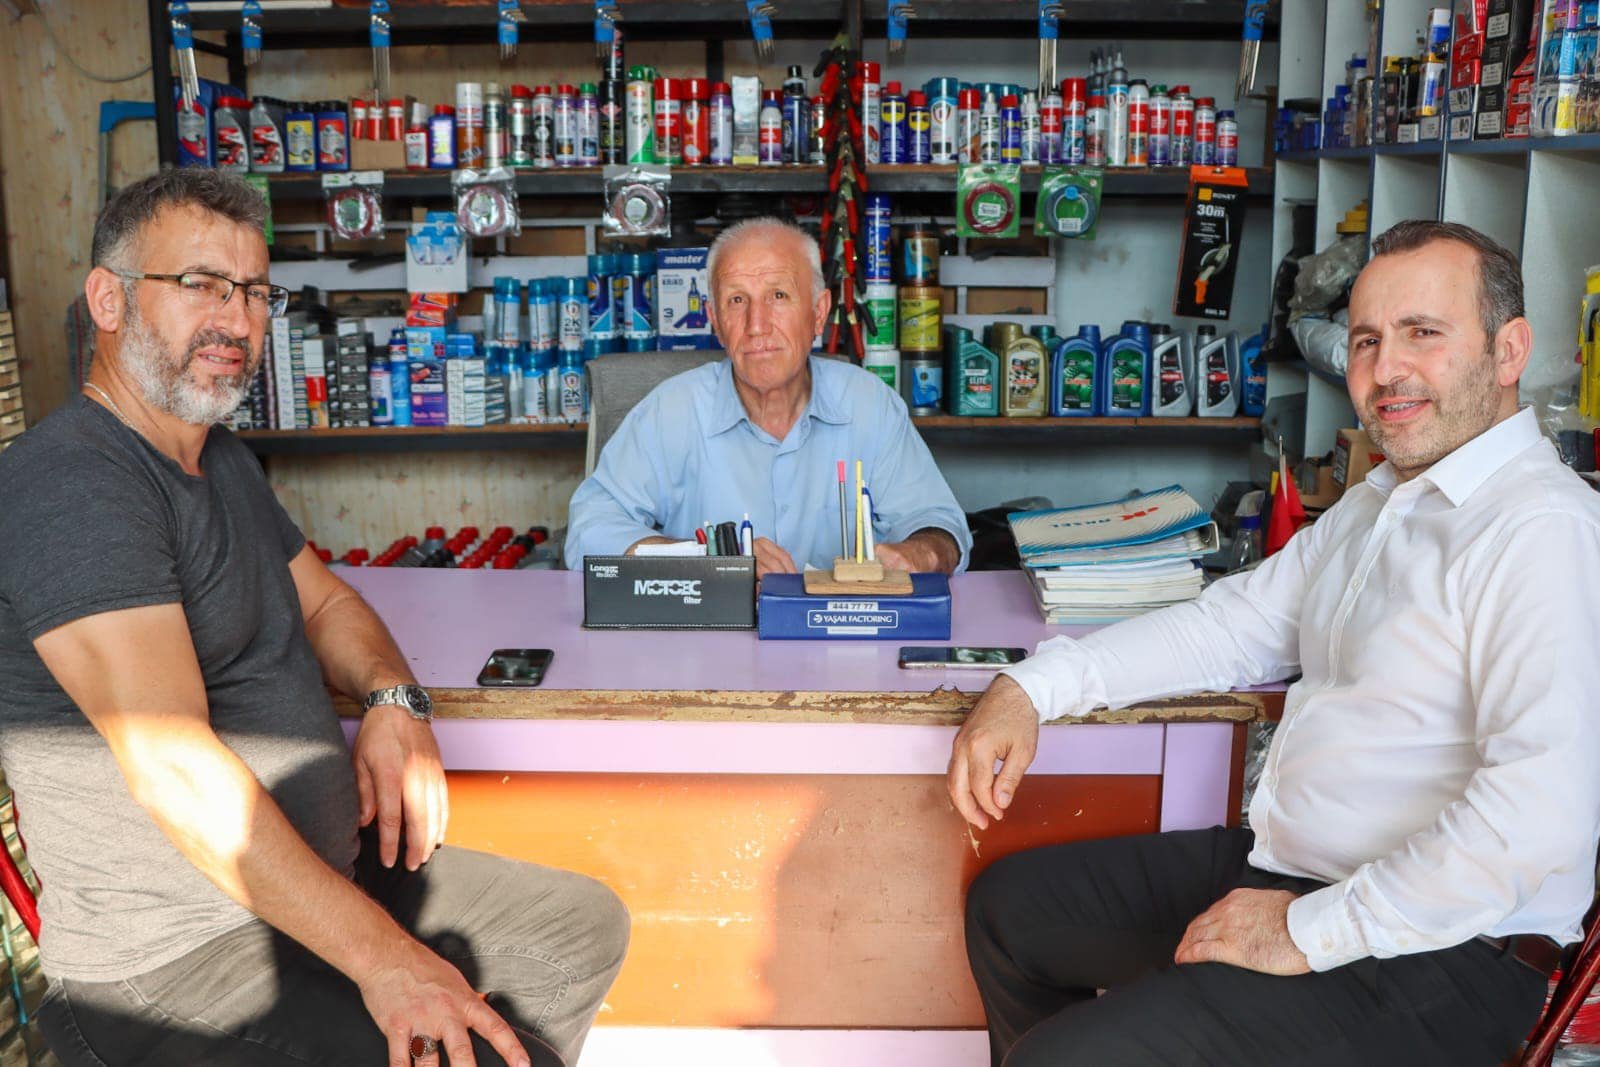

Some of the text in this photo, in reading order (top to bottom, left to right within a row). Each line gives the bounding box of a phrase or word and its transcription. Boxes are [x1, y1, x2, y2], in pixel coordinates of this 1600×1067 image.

[1196, 203, 1225, 217] 30m
[663, 308, 673, 318] 3
[683, 596, 702, 605] filter
[823, 615, 892, 624] YAŞAR FACTORING
